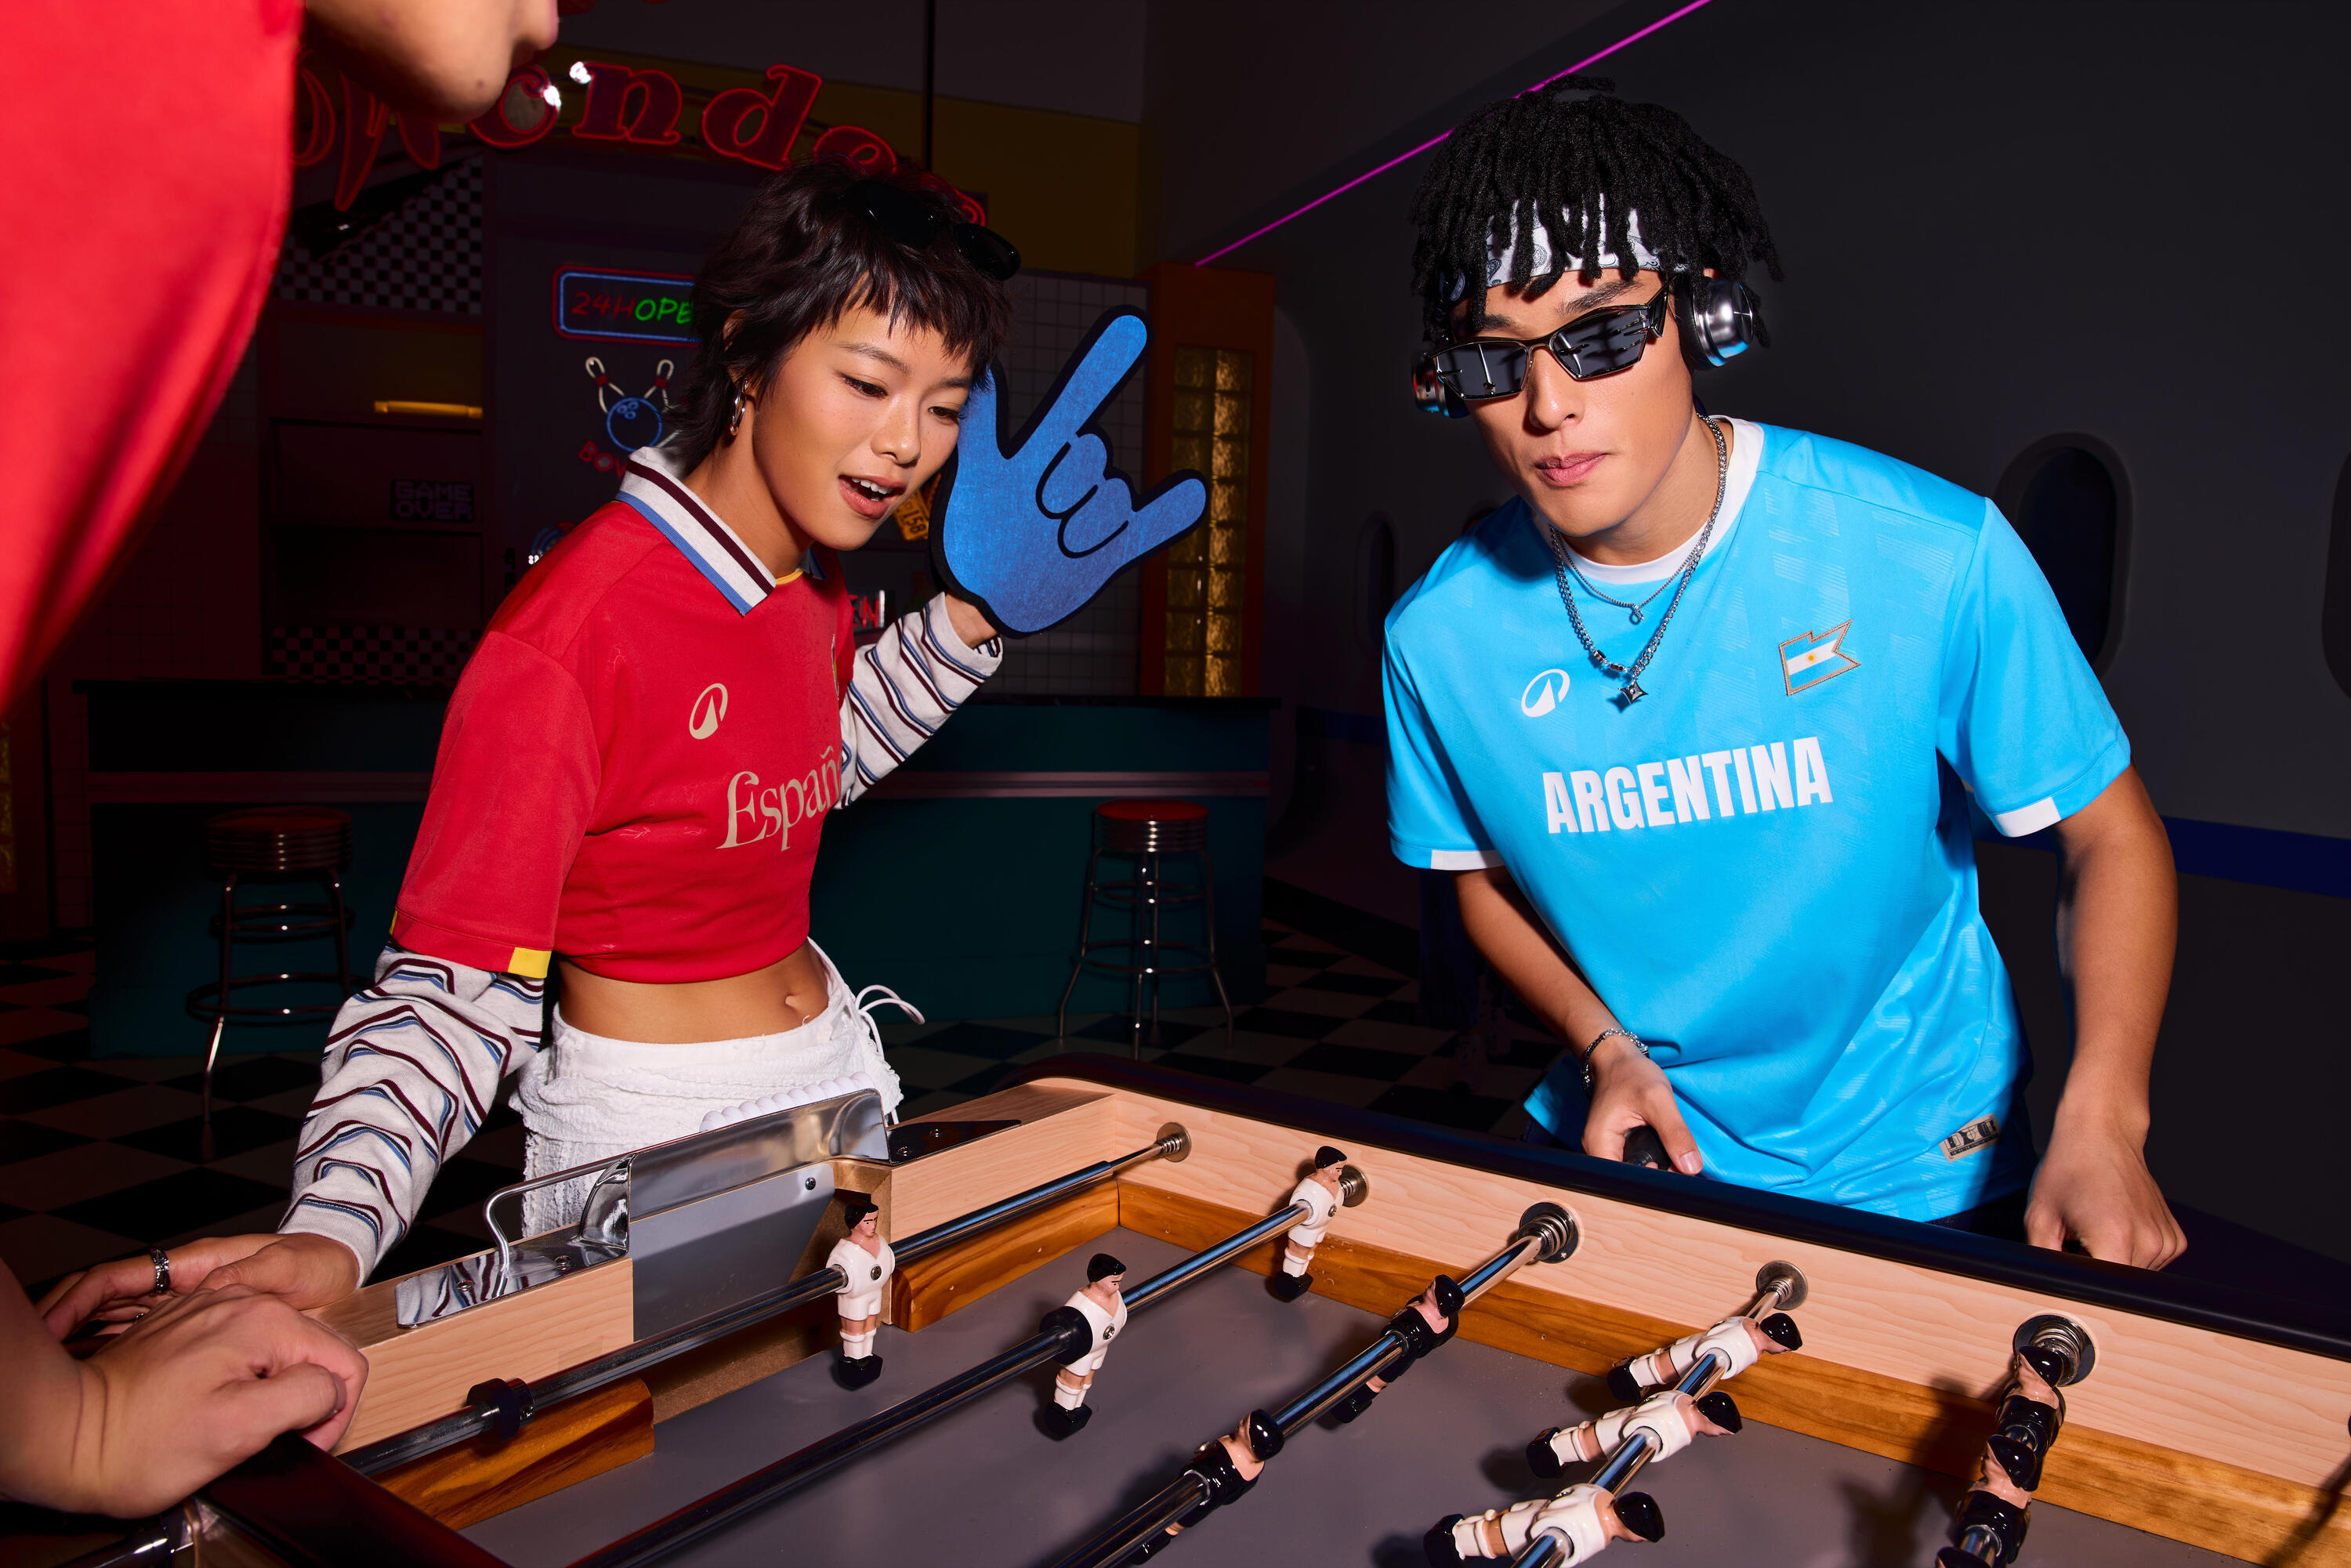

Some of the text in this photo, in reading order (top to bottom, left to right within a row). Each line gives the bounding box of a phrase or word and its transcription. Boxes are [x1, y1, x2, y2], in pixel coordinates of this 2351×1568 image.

[395, 480, 473, 502] GAME
[395, 501, 474, 520] OVER
[715, 745, 842, 851] Españ
[1542, 736, 1834, 835] ARGENTINA
